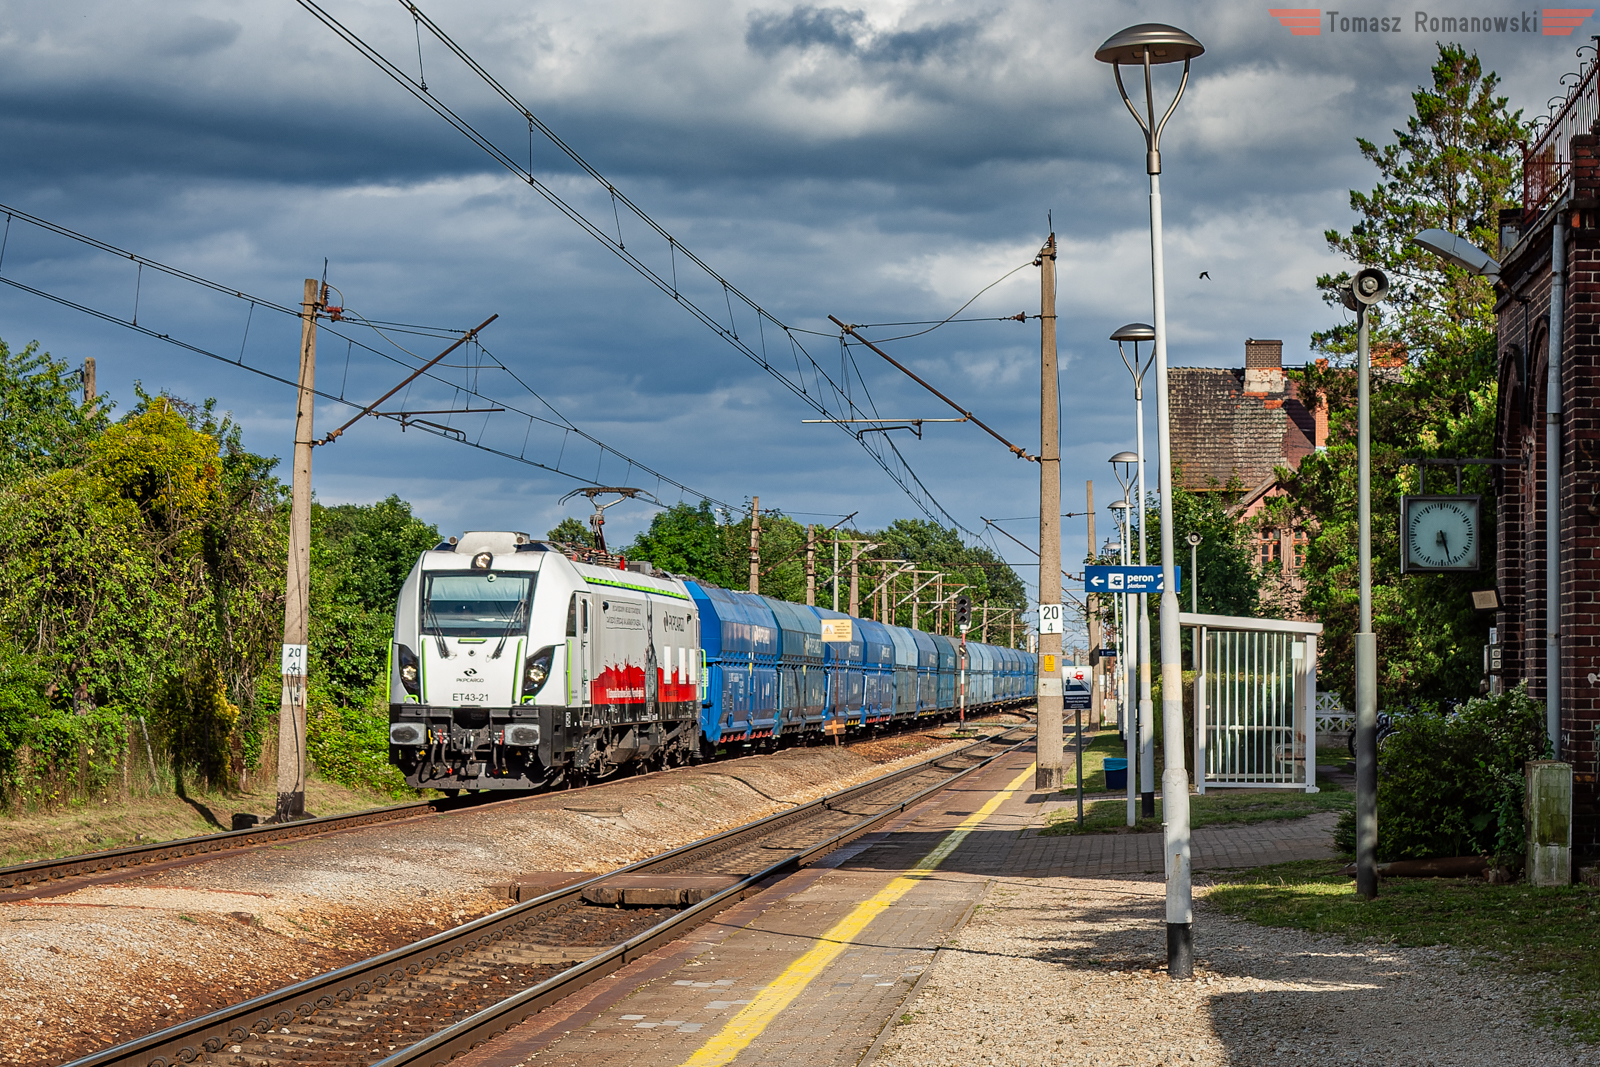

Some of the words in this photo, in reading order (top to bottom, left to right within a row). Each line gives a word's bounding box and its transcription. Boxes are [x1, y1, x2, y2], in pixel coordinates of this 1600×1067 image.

[1127, 574, 1154, 583] peron
[1043, 606, 1059, 620] 20
[1047, 623, 1053, 633] 4
[288, 648, 301, 658] 20
[452, 693, 489, 702] ET43-21
